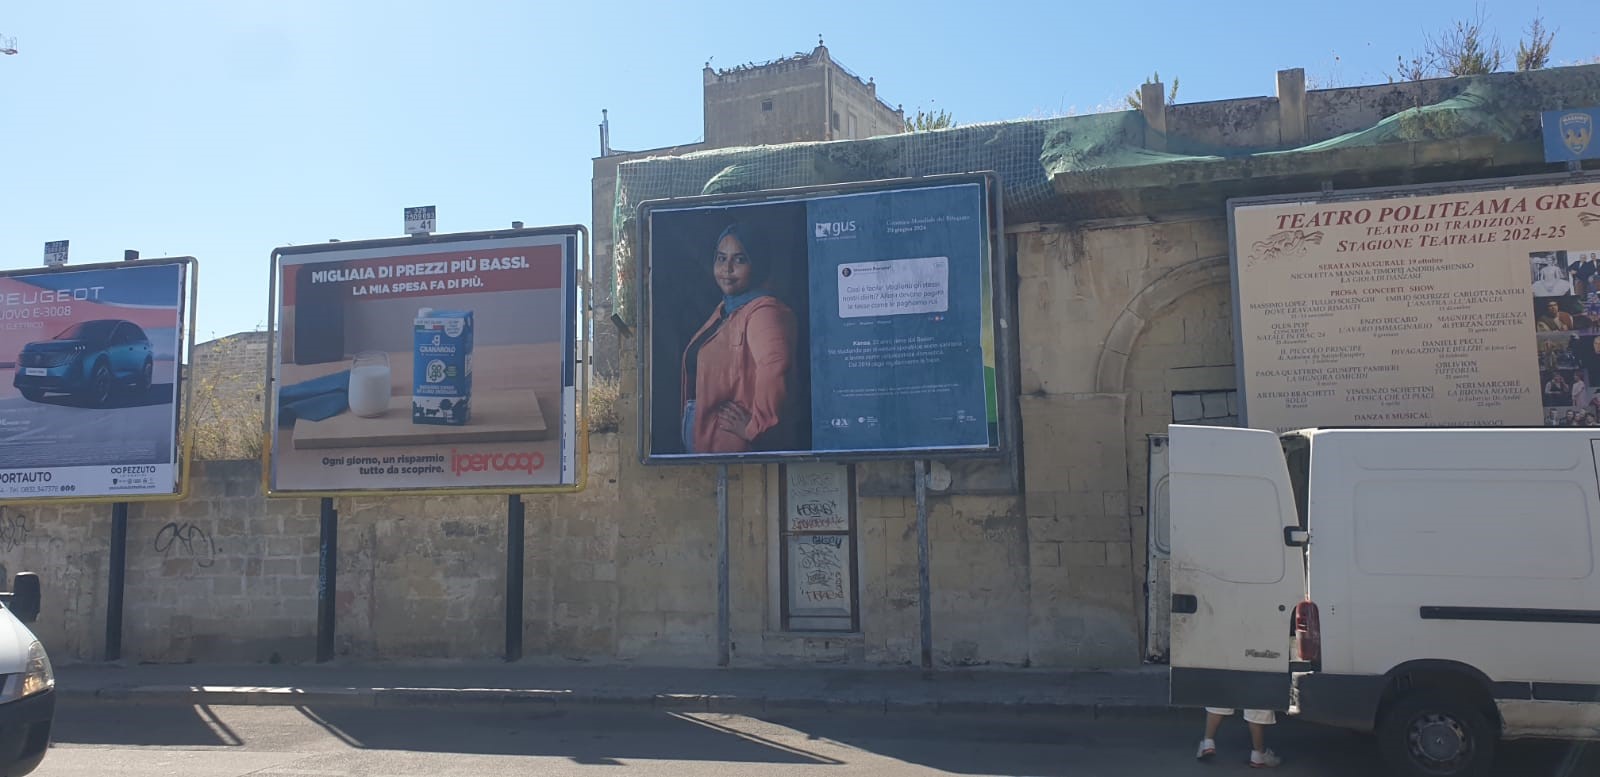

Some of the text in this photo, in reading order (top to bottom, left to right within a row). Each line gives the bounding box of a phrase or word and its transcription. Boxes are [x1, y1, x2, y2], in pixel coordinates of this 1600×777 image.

[1277, 208, 1371, 229] TEATRO
[1378, 197, 1527, 223] POLITEAMA
[420, 220, 431, 229] 41
[832, 220, 856, 236] gus
[1366, 216, 1535, 236] TEATRO DI TRADIZIONE
[1337, 225, 1566, 253] STAGIONE TEATRALE 2024-25
[312, 255, 529, 284] MIGLIAIA DI PREZZI PIÙ BASSI.
[1318, 262, 1350, 271] SERATA
[1352, 259, 1405, 269] INAUGURALE
[1291, 272, 1335, 281] NICOLETTA
[1336, 270, 1364, 279] MANNI
[353, 275, 483, 296] LA MIA SPESA FA DI PIÙ.
[0, 286, 104, 306] EUGEOT
[1330, 289, 1357, 297] PROSA
[1453, 290, 1494, 298] CARLOTTA
[1495, 288, 1525, 296] NATOLI
[33, 306, 71, 318] E-3008
[1250, 302, 1283, 310] MASSIMO
[1360, 318, 1381, 326] ENZO
[1437, 312, 1528, 322] MAGNIFICA PRESENZA
[1435, 360, 1477, 369] OBLIVION
[1257, 389, 1336, 399] ARTURO BRACHETTI
[1345, 387, 1389, 396] VINCENZO
[322, 454, 445, 467] Ogni giorno, un risparmio
[451, 448, 545, 477] ipercoop
[359, 464, 445, 475] tutto da scoprire.
[0, 471, 52, 484] ORTAUTO
